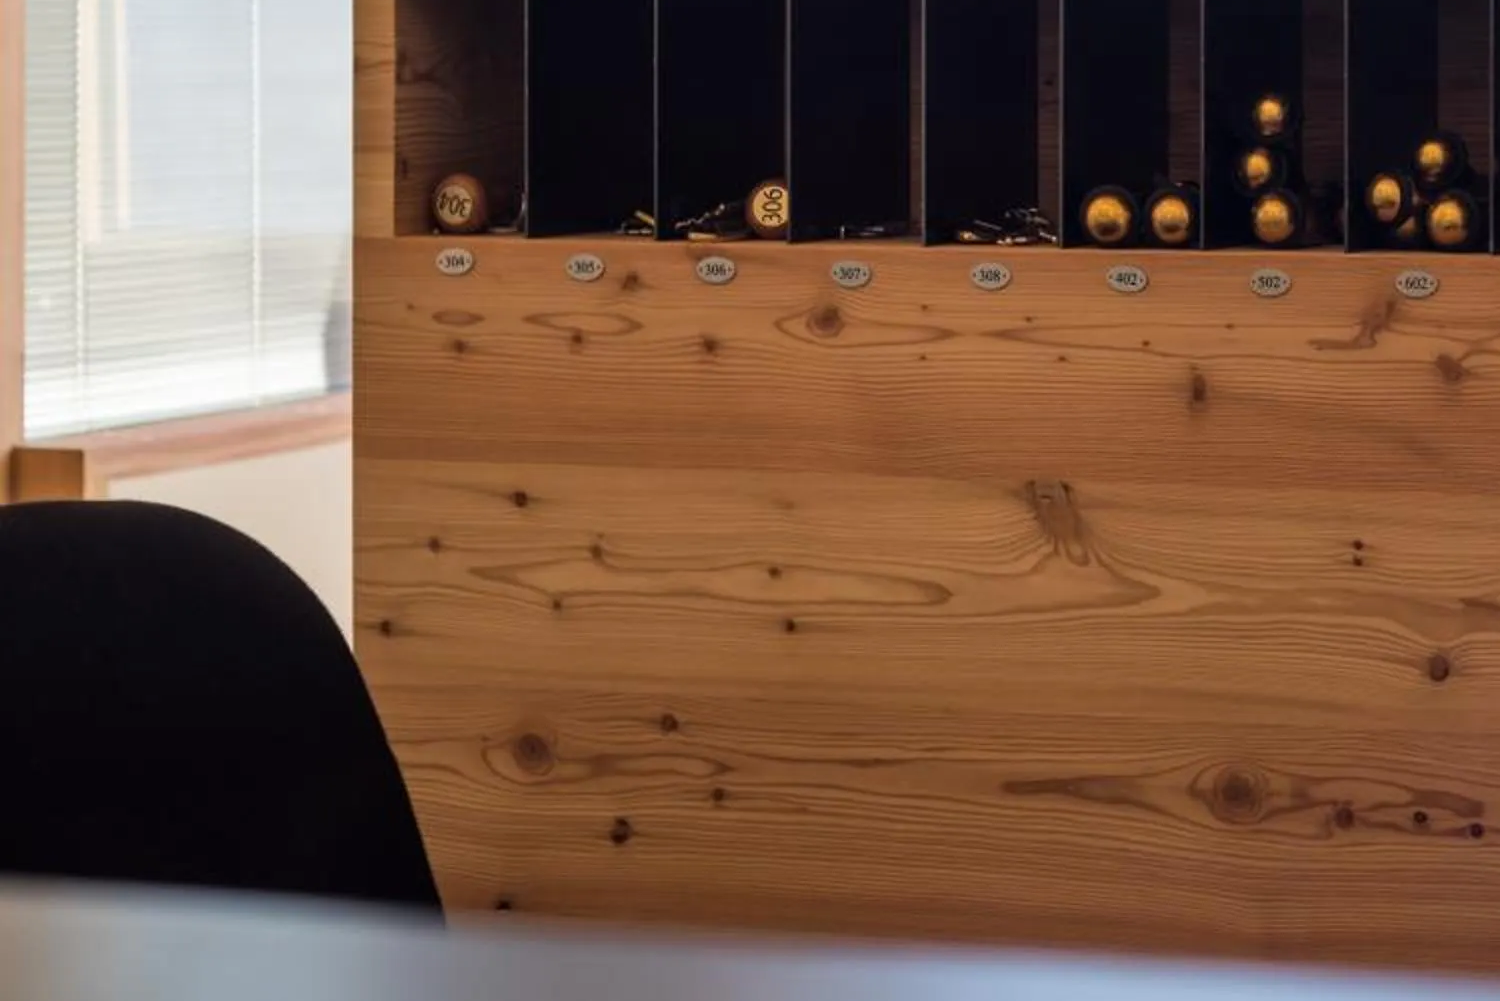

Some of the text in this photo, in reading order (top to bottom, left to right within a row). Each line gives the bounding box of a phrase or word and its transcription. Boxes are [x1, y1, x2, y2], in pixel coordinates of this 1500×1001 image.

[761, 188, 783, 224] 306
[704, 263, 726, 277] 306
[840, 267, 861, 280] 307
[979, 269, 1000, 282] 308
[1116, 272, 1137, 286] 402
[1258, 275, 1280, 288] 502
[1405, 276, 1427, 289] 602
